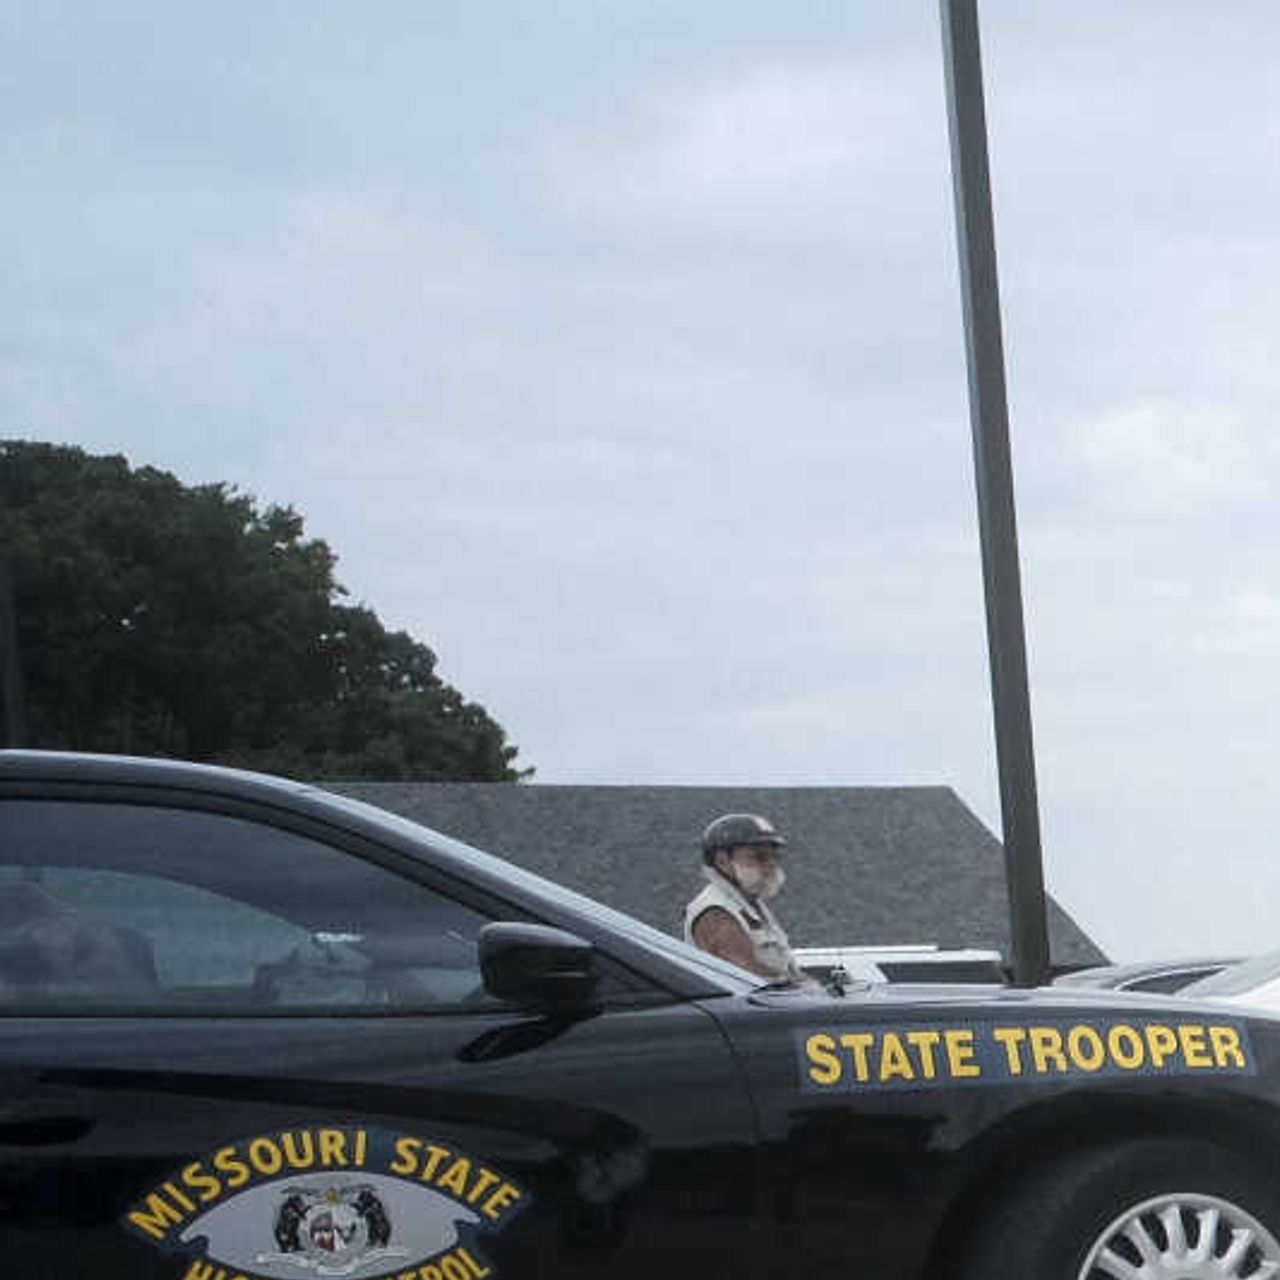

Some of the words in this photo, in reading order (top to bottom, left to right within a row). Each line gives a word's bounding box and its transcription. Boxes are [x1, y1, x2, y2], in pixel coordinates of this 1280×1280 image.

[804, 1031, 981, 1086] STATE
[994, 1023, 1247, 1074] TROOPER
[128, 1129, 366, 1240] MISSOURI
[389, 1137, 522, 1220] STATE
